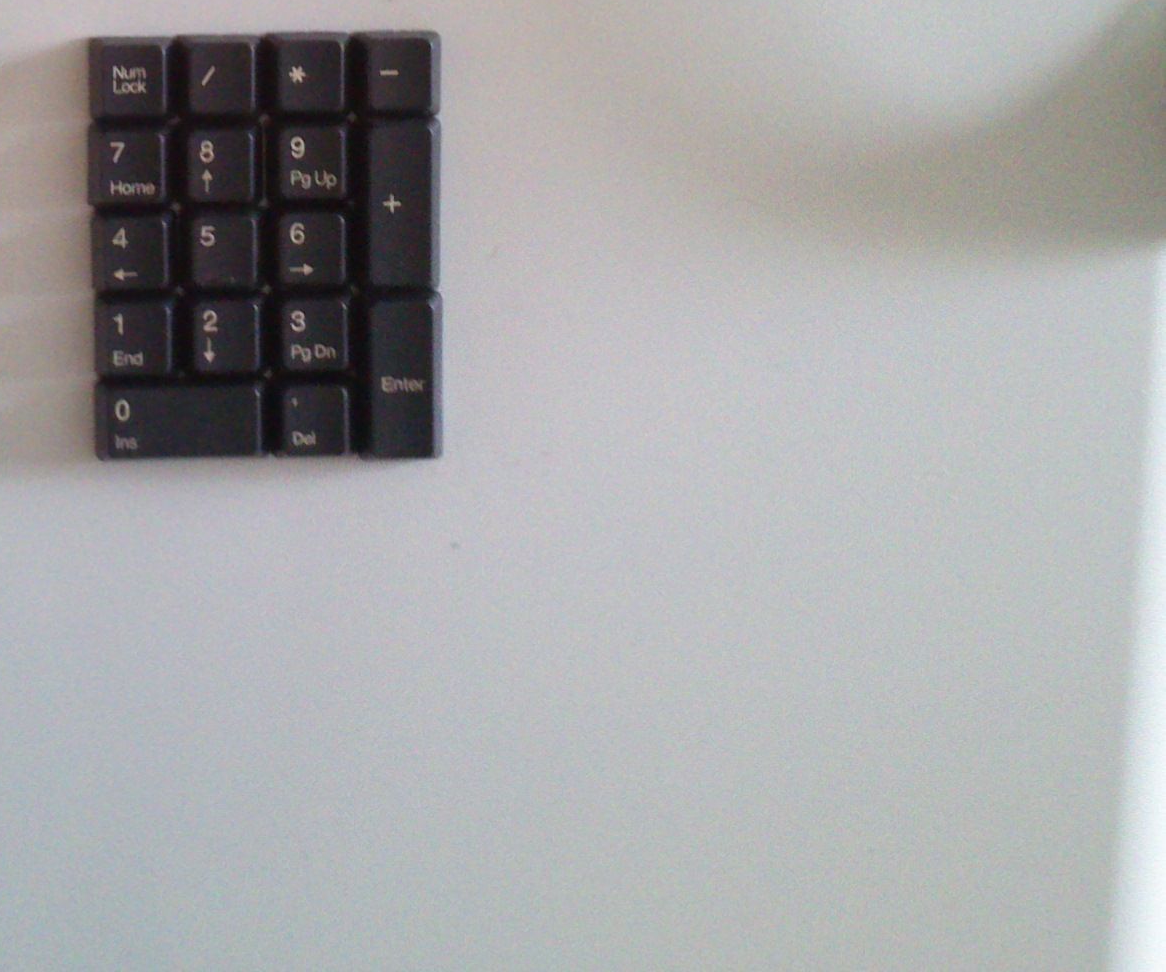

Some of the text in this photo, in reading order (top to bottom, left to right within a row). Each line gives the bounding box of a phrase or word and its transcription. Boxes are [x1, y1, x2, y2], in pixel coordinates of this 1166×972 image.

[112, 65, 147, 80] Num
[112, 79, 147, 95] Lock
[109, 141, 125, 164] 7
[199, 140, 215, 163] 8
[290, 136, 306, 159] 9
[109, 180, 156, 196] Home
[290, 169, 337, 190] Pg Up
[111, 227, 129, 249] 4
[200, 225, 215, 247] 5
[289, 222, 305, 245] 6
[113, 313, 124, 335] 1
[202, 309, 218, 332] 2
[290, 310, 306, 333] 3
[112, 350, 144, 367] End
[290, 343, 336, 363] Pg Dn
[380, 376, 425, 393] Enter
[114, 399, 131, 422] 0
[114, 434, 139, 450] Ins
[292, 430, 316, 446] Del
